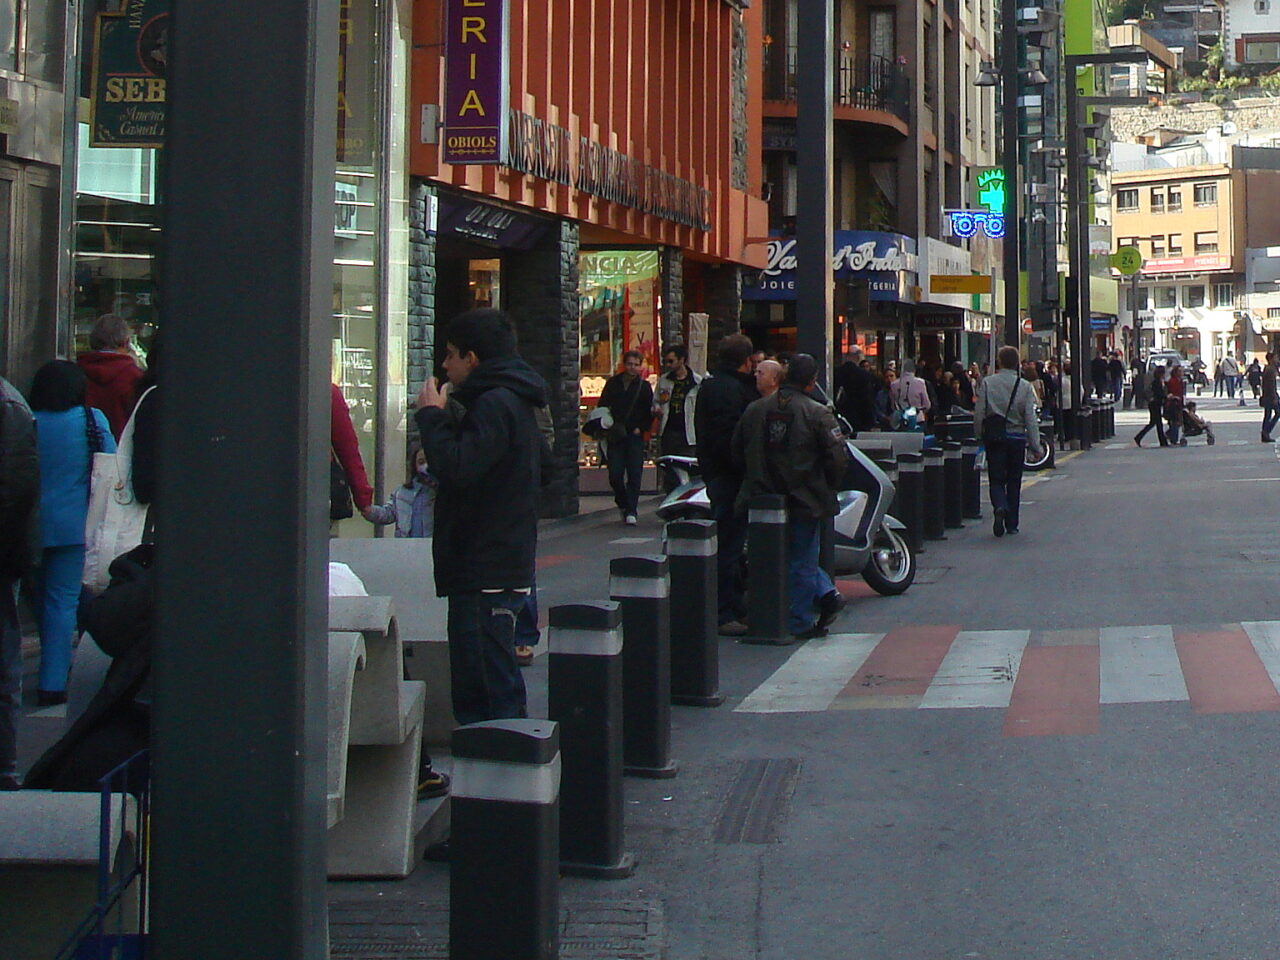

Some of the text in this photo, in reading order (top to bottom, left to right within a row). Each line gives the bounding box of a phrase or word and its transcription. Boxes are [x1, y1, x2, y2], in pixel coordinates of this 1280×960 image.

[106, 78, 166, 102] SEB
[448, 136, 496, 148] OBIOLS
[760, 281, 795, 289] JOIE
